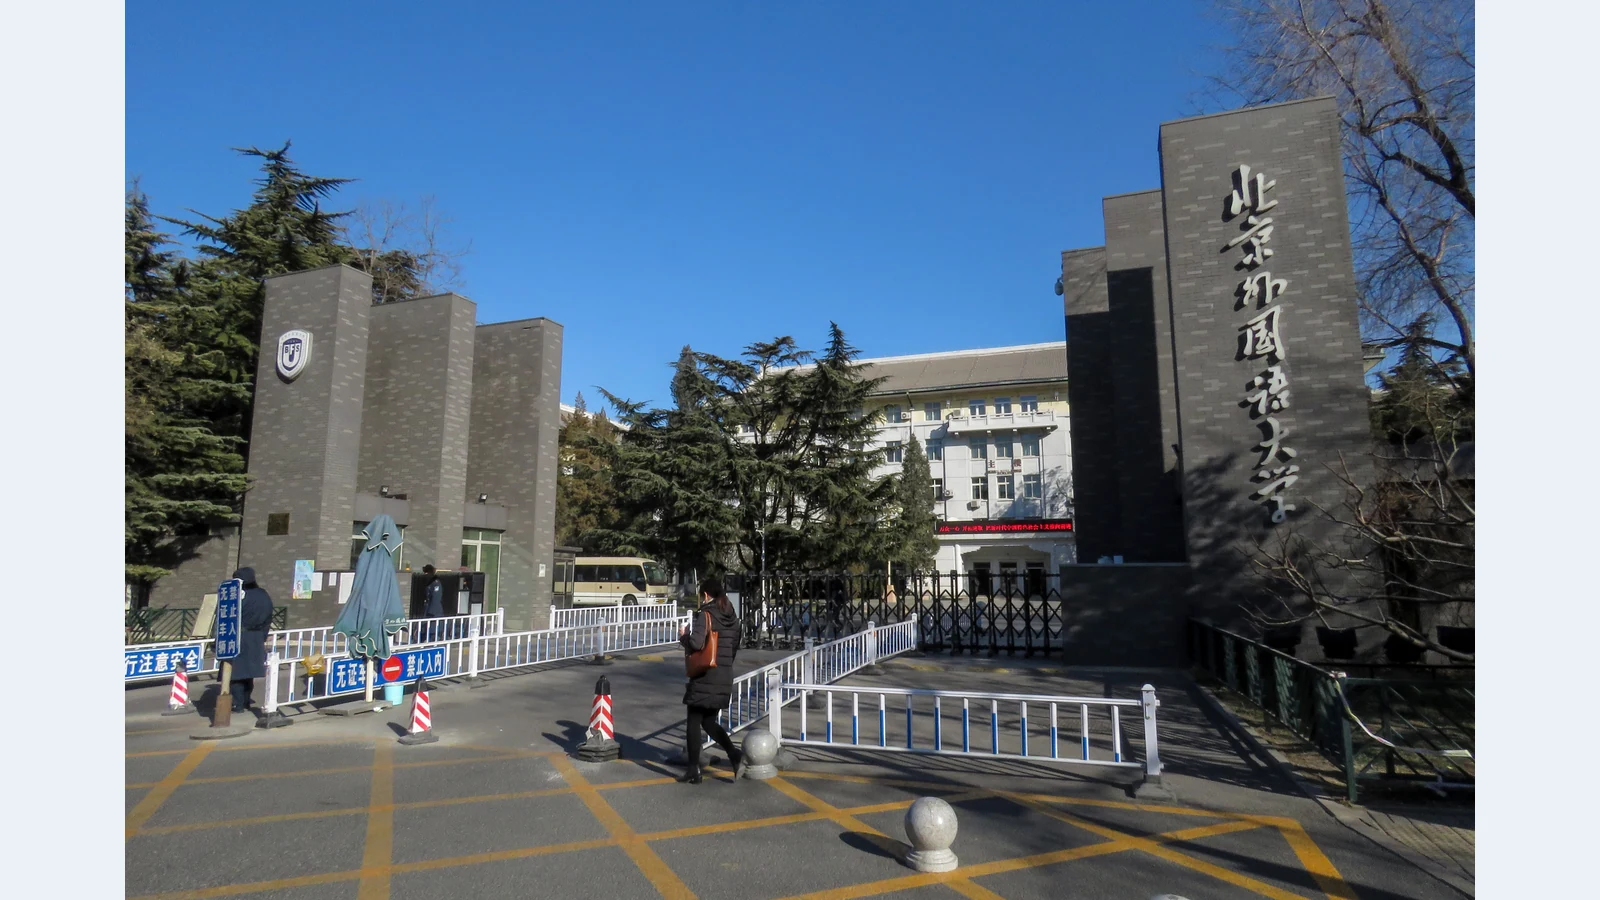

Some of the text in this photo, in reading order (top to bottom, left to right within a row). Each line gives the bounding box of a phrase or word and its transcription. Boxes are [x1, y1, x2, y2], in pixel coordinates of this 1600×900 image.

[218, 587, 228, 654] 无证车辆
[228, 586, 238, 654] 禁止入内
[336, 651, 442, 688] 无证车 禁止入内
